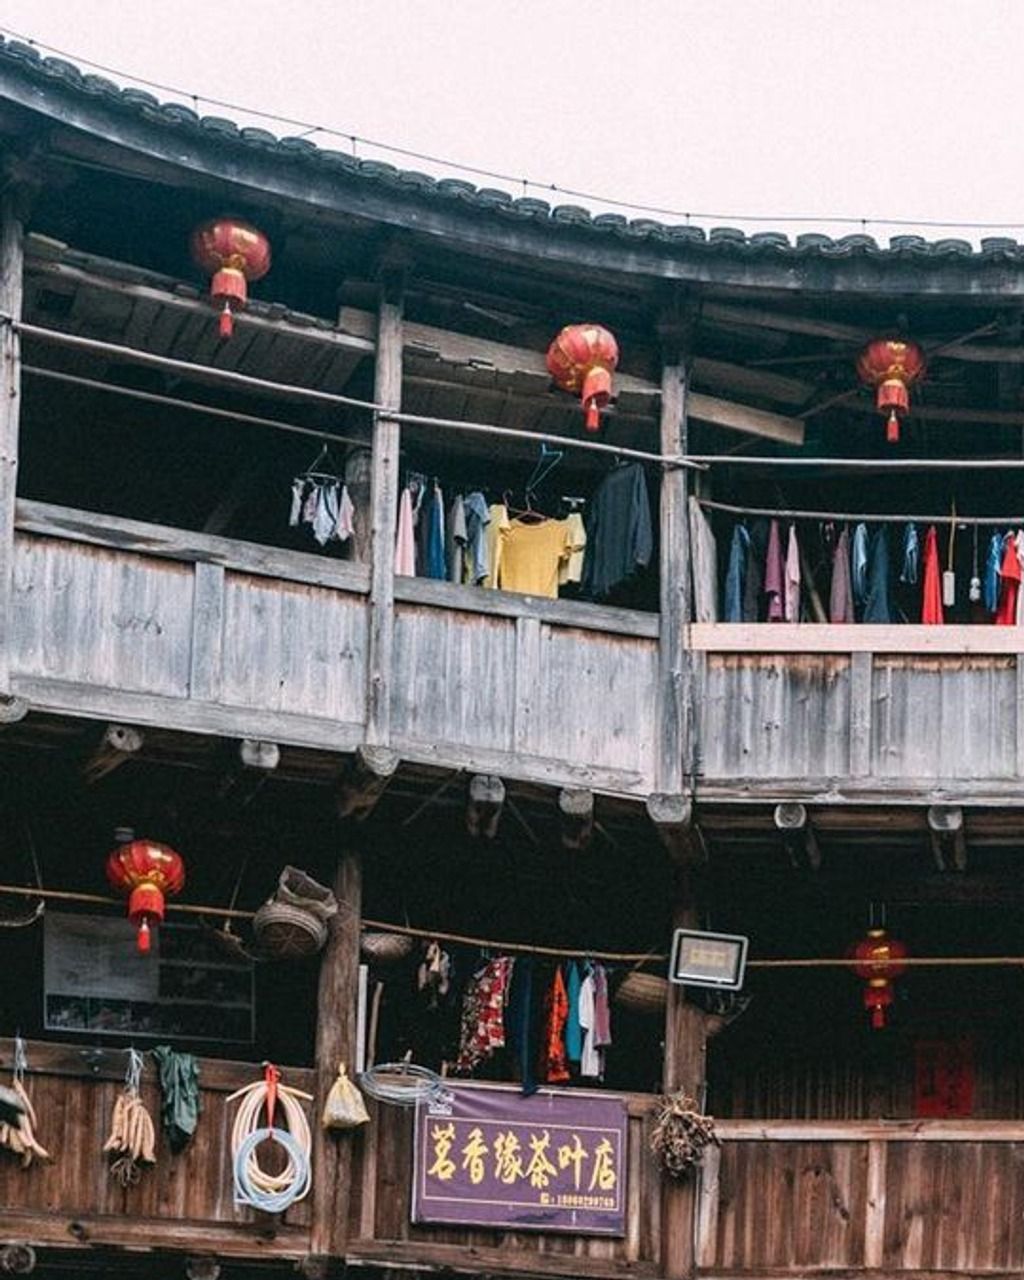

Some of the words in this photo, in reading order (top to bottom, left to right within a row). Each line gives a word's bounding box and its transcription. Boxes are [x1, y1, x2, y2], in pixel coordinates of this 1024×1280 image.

[428, 1122, 616, 1192] 茗香缘茶叶店
